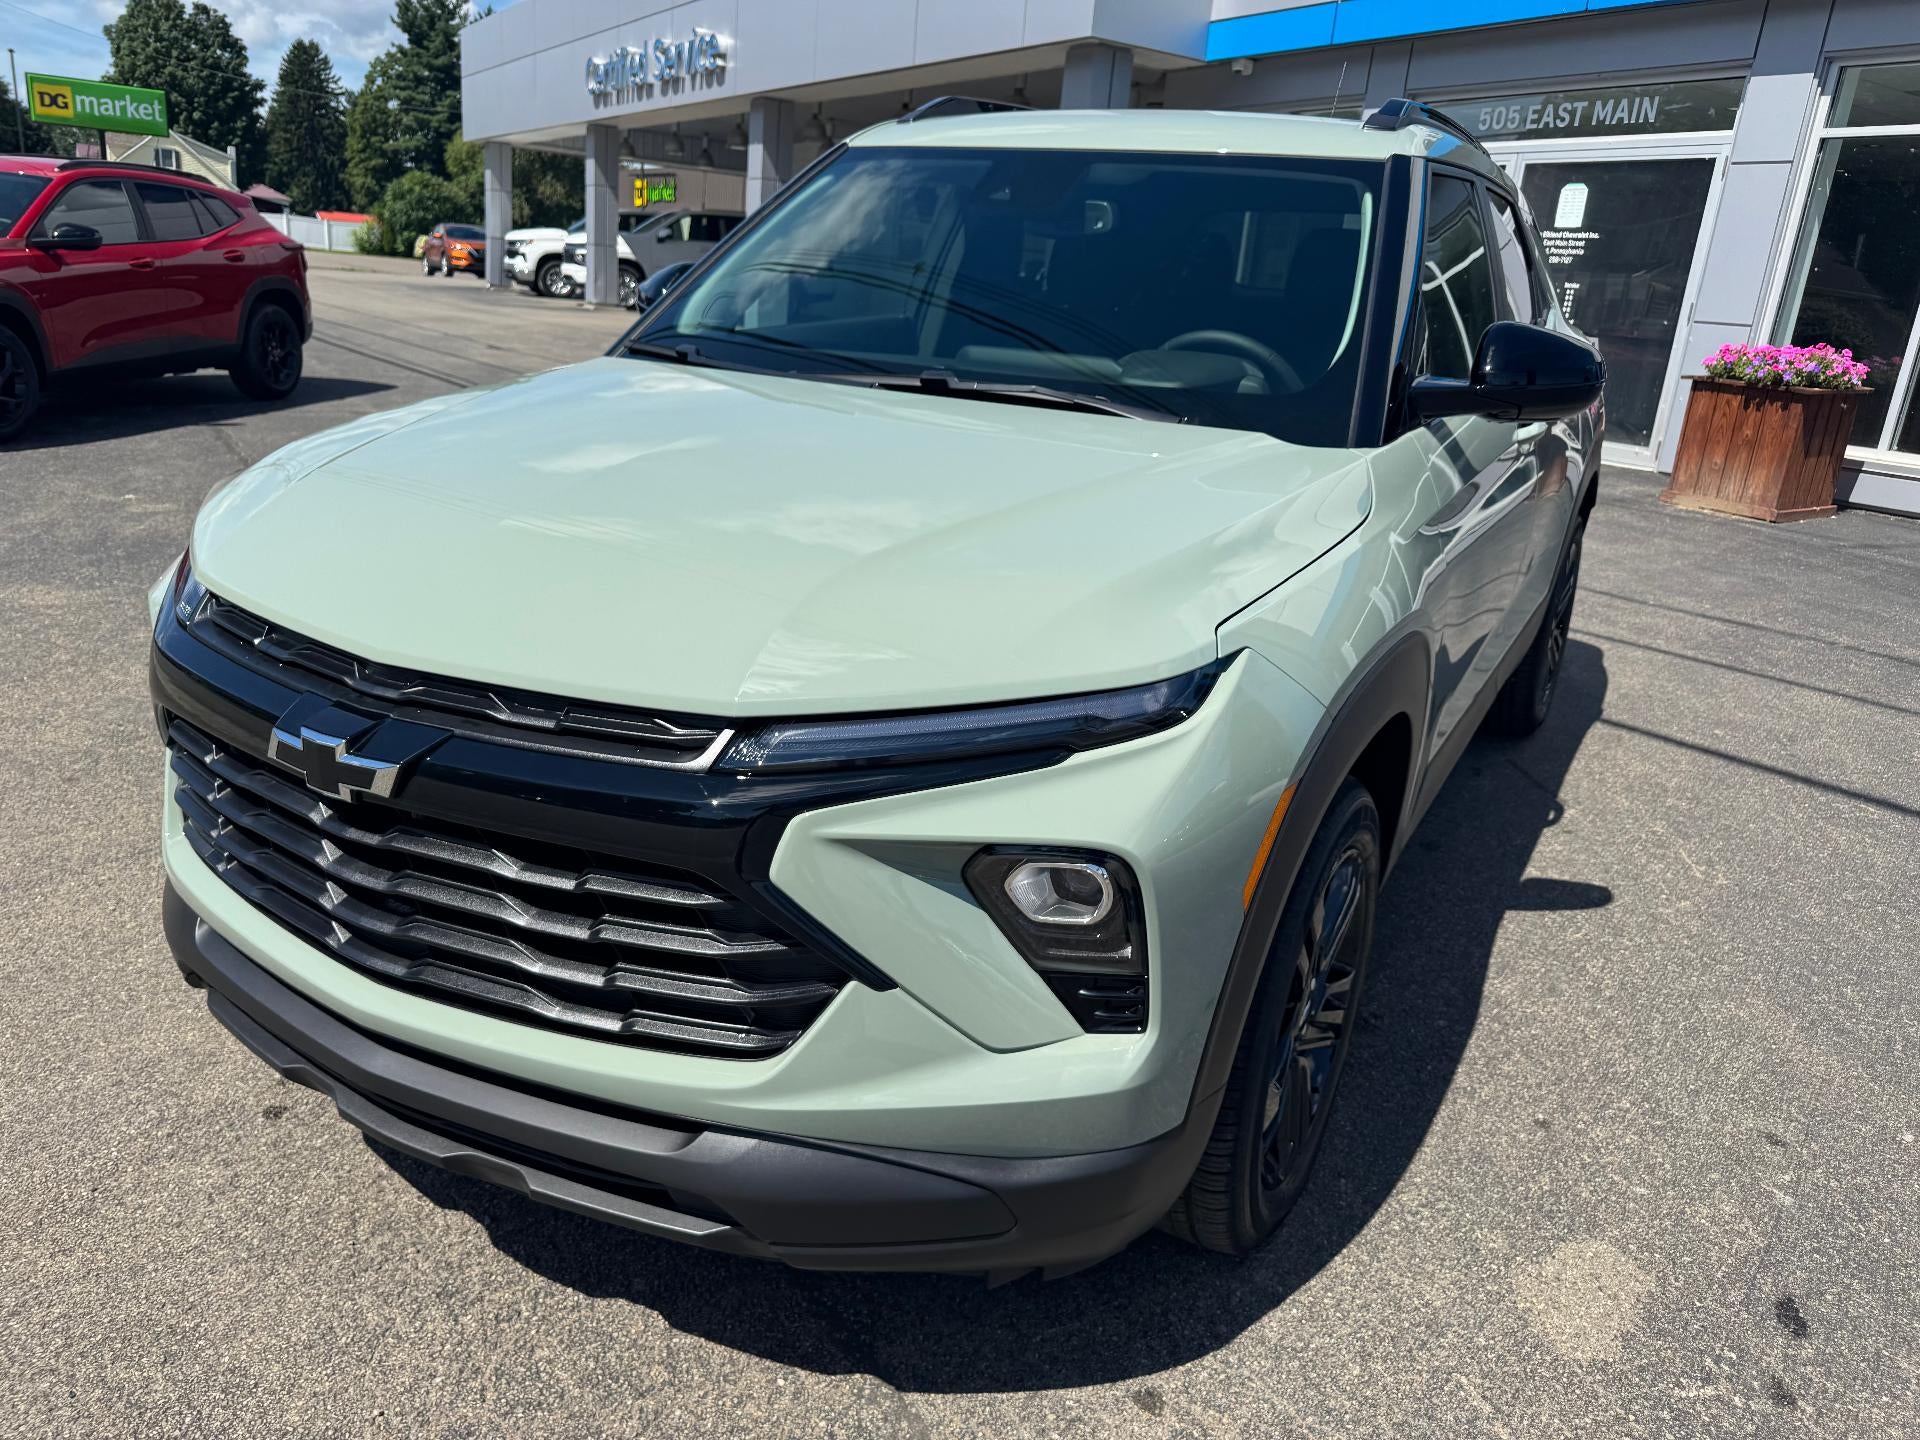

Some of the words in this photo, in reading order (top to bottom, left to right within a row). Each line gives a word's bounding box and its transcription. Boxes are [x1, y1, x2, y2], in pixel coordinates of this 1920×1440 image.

[585, 40, 649, 95] Certified
[653, 25, 720, 81] Service
[36, 90, 70, 110] DG
[75, 94, 164, 122] market
[1478, 105, 1520, 131] 505
[1525, 101, 1589, 130] EAST
[1591, 95, 1660, 126] MAIN
